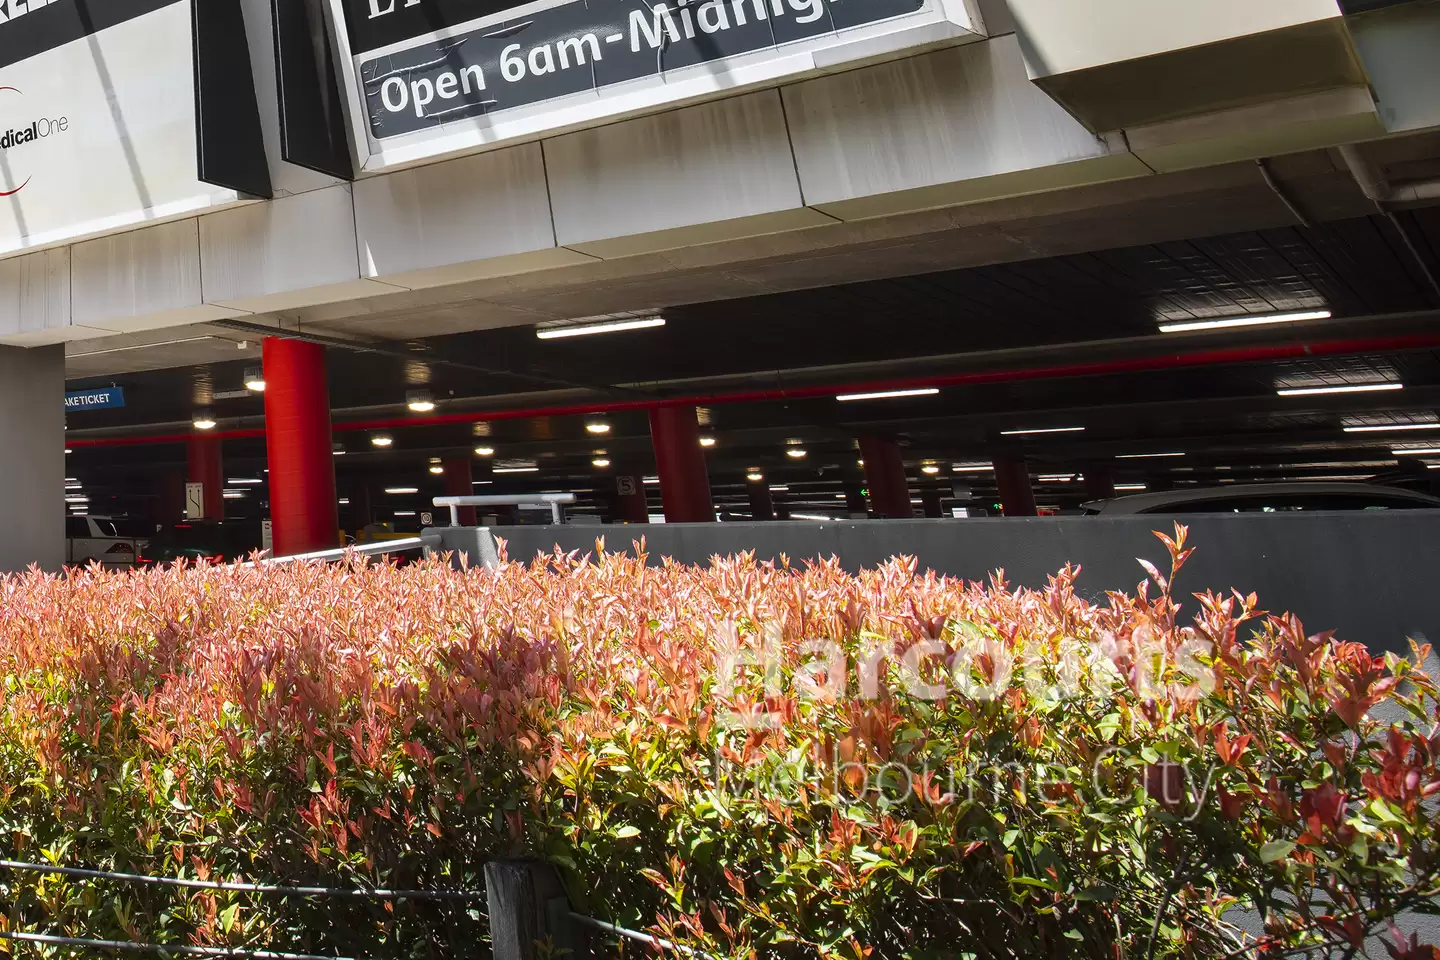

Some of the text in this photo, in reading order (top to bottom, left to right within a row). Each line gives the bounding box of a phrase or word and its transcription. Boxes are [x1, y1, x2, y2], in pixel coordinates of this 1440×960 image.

[379, 64, 487, 119] Open
[64, 393, 110, 407] AKE TICKET
